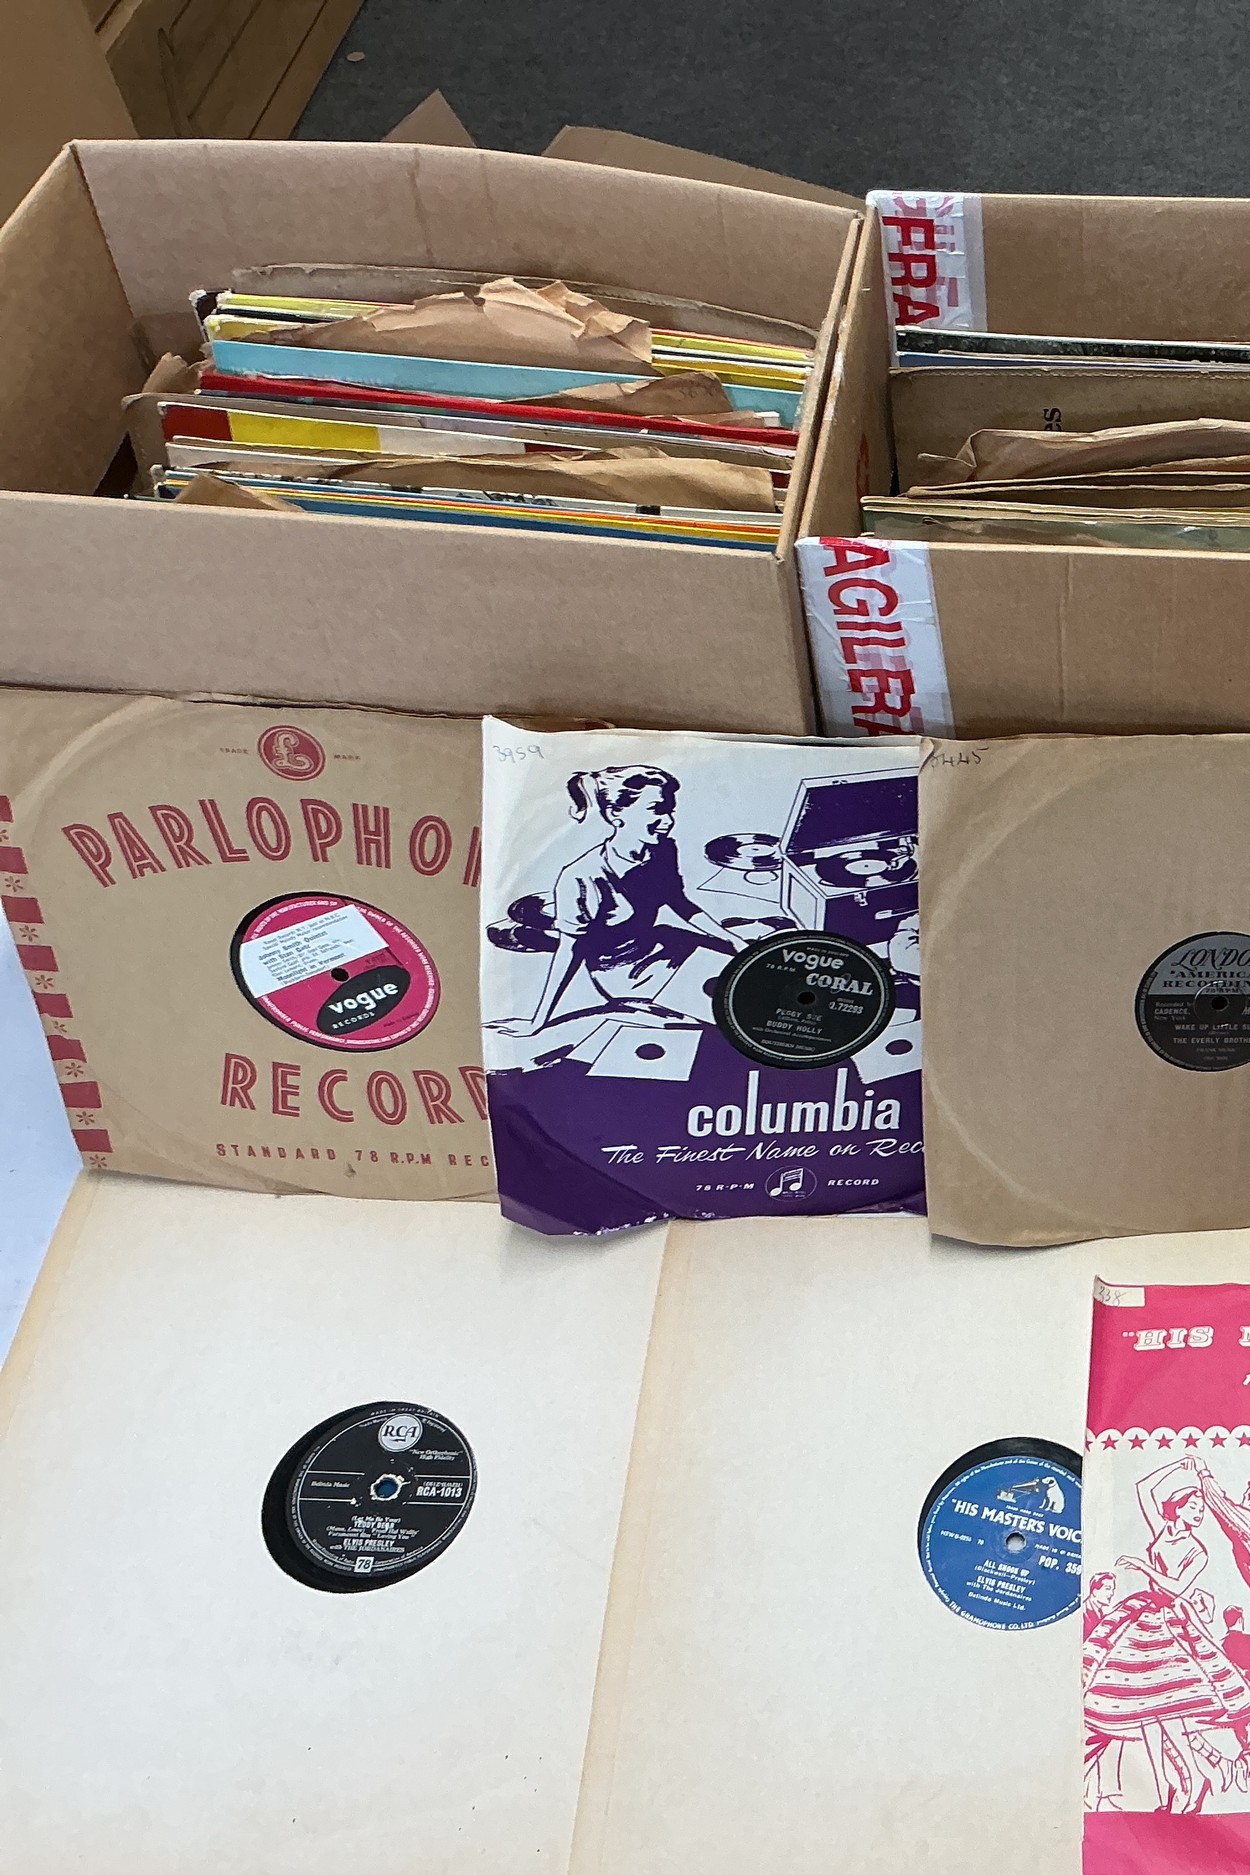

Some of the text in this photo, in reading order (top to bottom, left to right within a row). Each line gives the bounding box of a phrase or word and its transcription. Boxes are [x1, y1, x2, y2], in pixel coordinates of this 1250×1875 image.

[806, 972, 873, 996] CORAL
[328, 982, 399, 1014] vogue
[332, 1012, 376, 1029] RECORDS
[766, 1020, 793, 1030] BUDDY
[796, 1024, 823, 1035] HOLLY
[687, 1068, 901, 1138] columbia
[216, 1144, 336, 1161] STANDARD
[355, 1150, 379, 1163] 78
[601, 1145, 644, 1165] The
[655, 1146, 746, 1164] Finest
[746, 1142, 820, 1162] Name
[829, 1146, 860, 1157] on
[695, 1184, 712, 1193] 78
[827, 1177, 880, 1187] RECORD
[384, 1425, 418, 1438] RCA
[416, 1486, 463, 1498] RCA-1013
[343, 1538, 394, 1547] ELVIS PRESLEY
[357, 1560, 371, 1569] 78
[984, 1560, 996, 1569] ALL
[977, 1576, 1026, 1593] ELVIS PRESLEY
